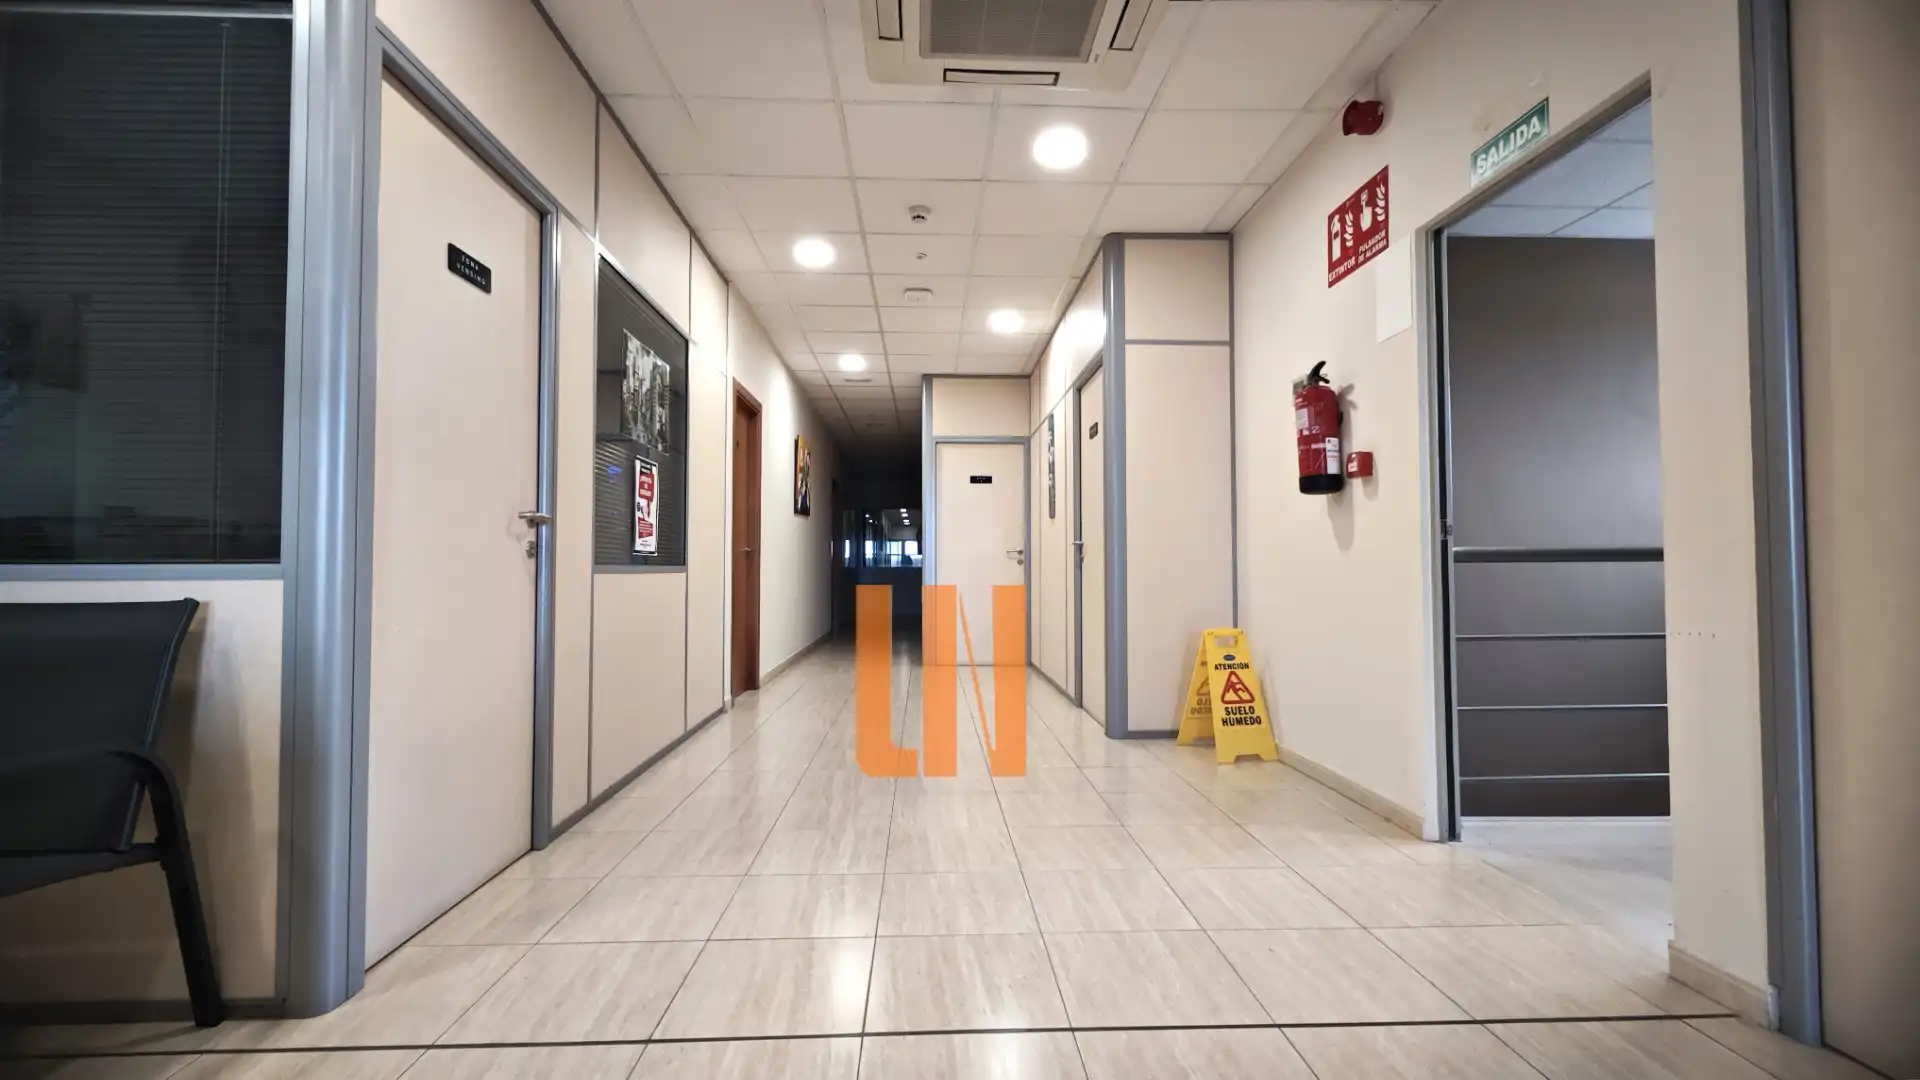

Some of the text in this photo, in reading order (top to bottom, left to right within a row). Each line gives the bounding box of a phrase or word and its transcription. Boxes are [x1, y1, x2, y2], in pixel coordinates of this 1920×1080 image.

[1476, 115, 1541, 175] SALIDA
[1358, 238, 1387, 264] DE ALARMA
[1359, 229, 1386, 255] PULSADOR
[456, 261, 486, 285] VENDING
[461, 255, 479, 271] ZONA
[1328, 256, 1356, 282] EXTINTOR
[1221, 715, 1263, 727] HUMEDO
[1224, 705, 1256, 716] SUELO
